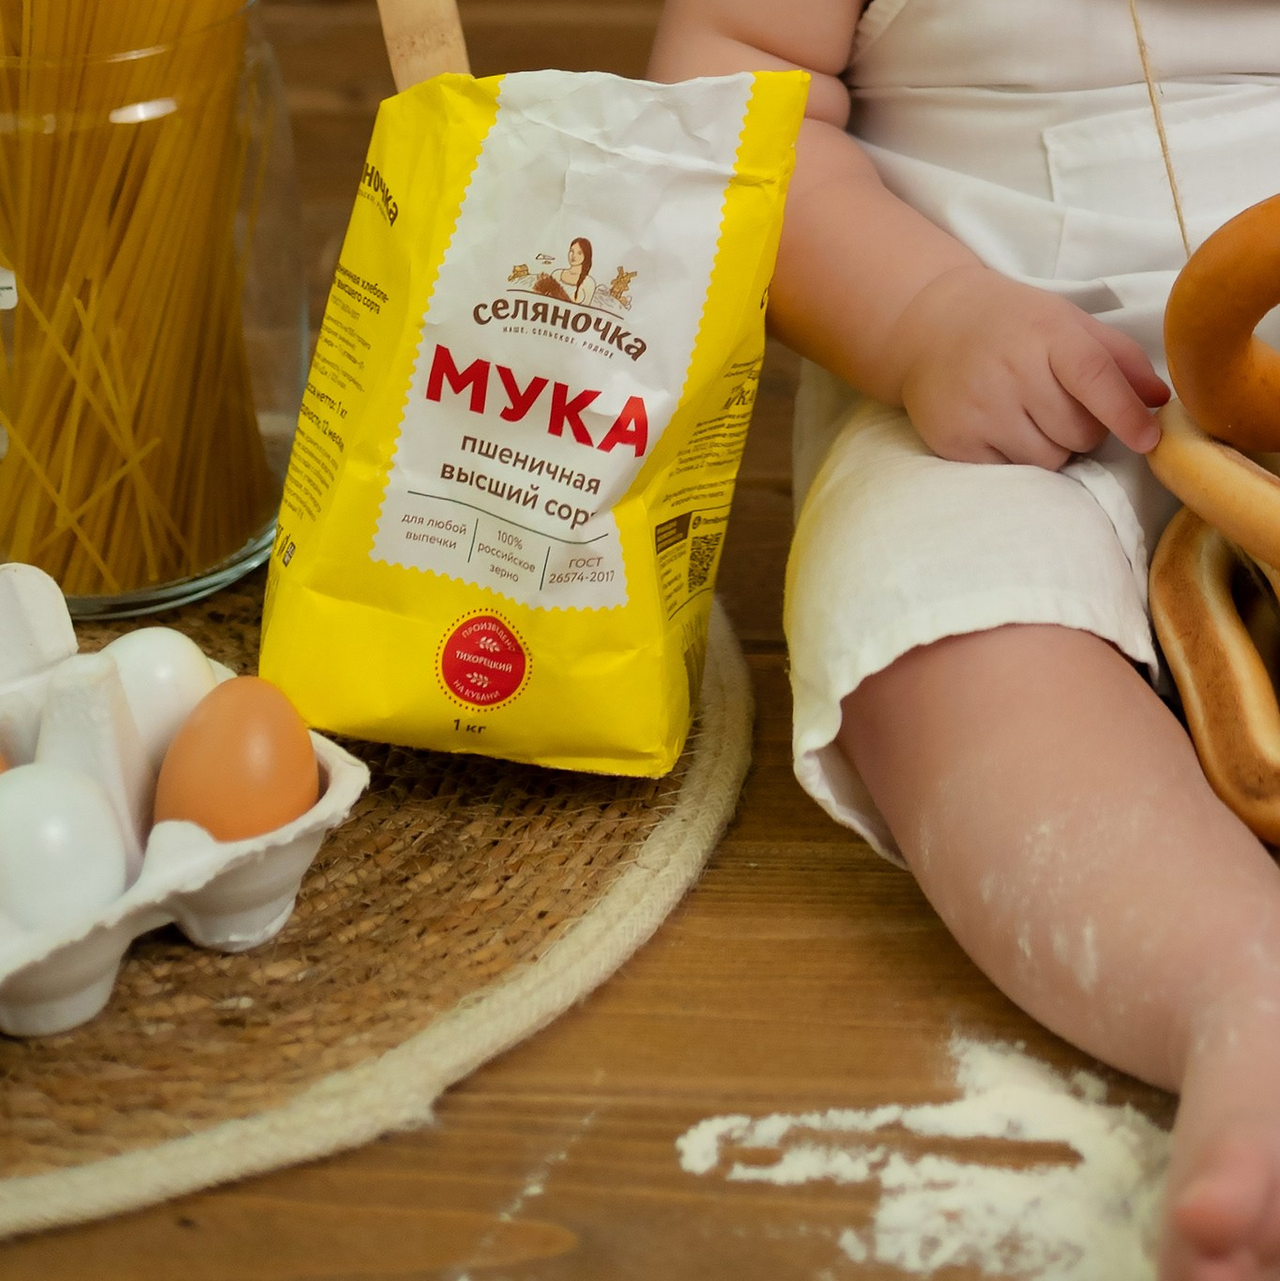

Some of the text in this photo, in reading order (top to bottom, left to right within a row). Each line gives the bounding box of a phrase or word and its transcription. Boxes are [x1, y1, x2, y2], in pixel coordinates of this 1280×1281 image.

[361, 161, 399, 227] ночка
[473, 298, 648, 362] селяночка
[582, 340, 615, 360] РОДНОЕ
[425, 343, 649, 458] МУКА
[460, 435, 601, 496] пшеничная
[439, 462, 540, 510] высший
[401, 513, 467, 536] для любой
[405, 530, 457, 550] выпечки
[497, 529, 524, 550] 100%
[477, 542, 536, 573] российское
[568, 556, 604, 569] ГОСТ
[489, 563, 520, 583] зерно
[548, 569, 615, 585] 26574-2017
[455, 650, 513, 673] ТИХОРЕЦКИЙ
[453, 680, 501, 702] НА КУБАНИ
[453, 718, 487, 734] 1 кг
